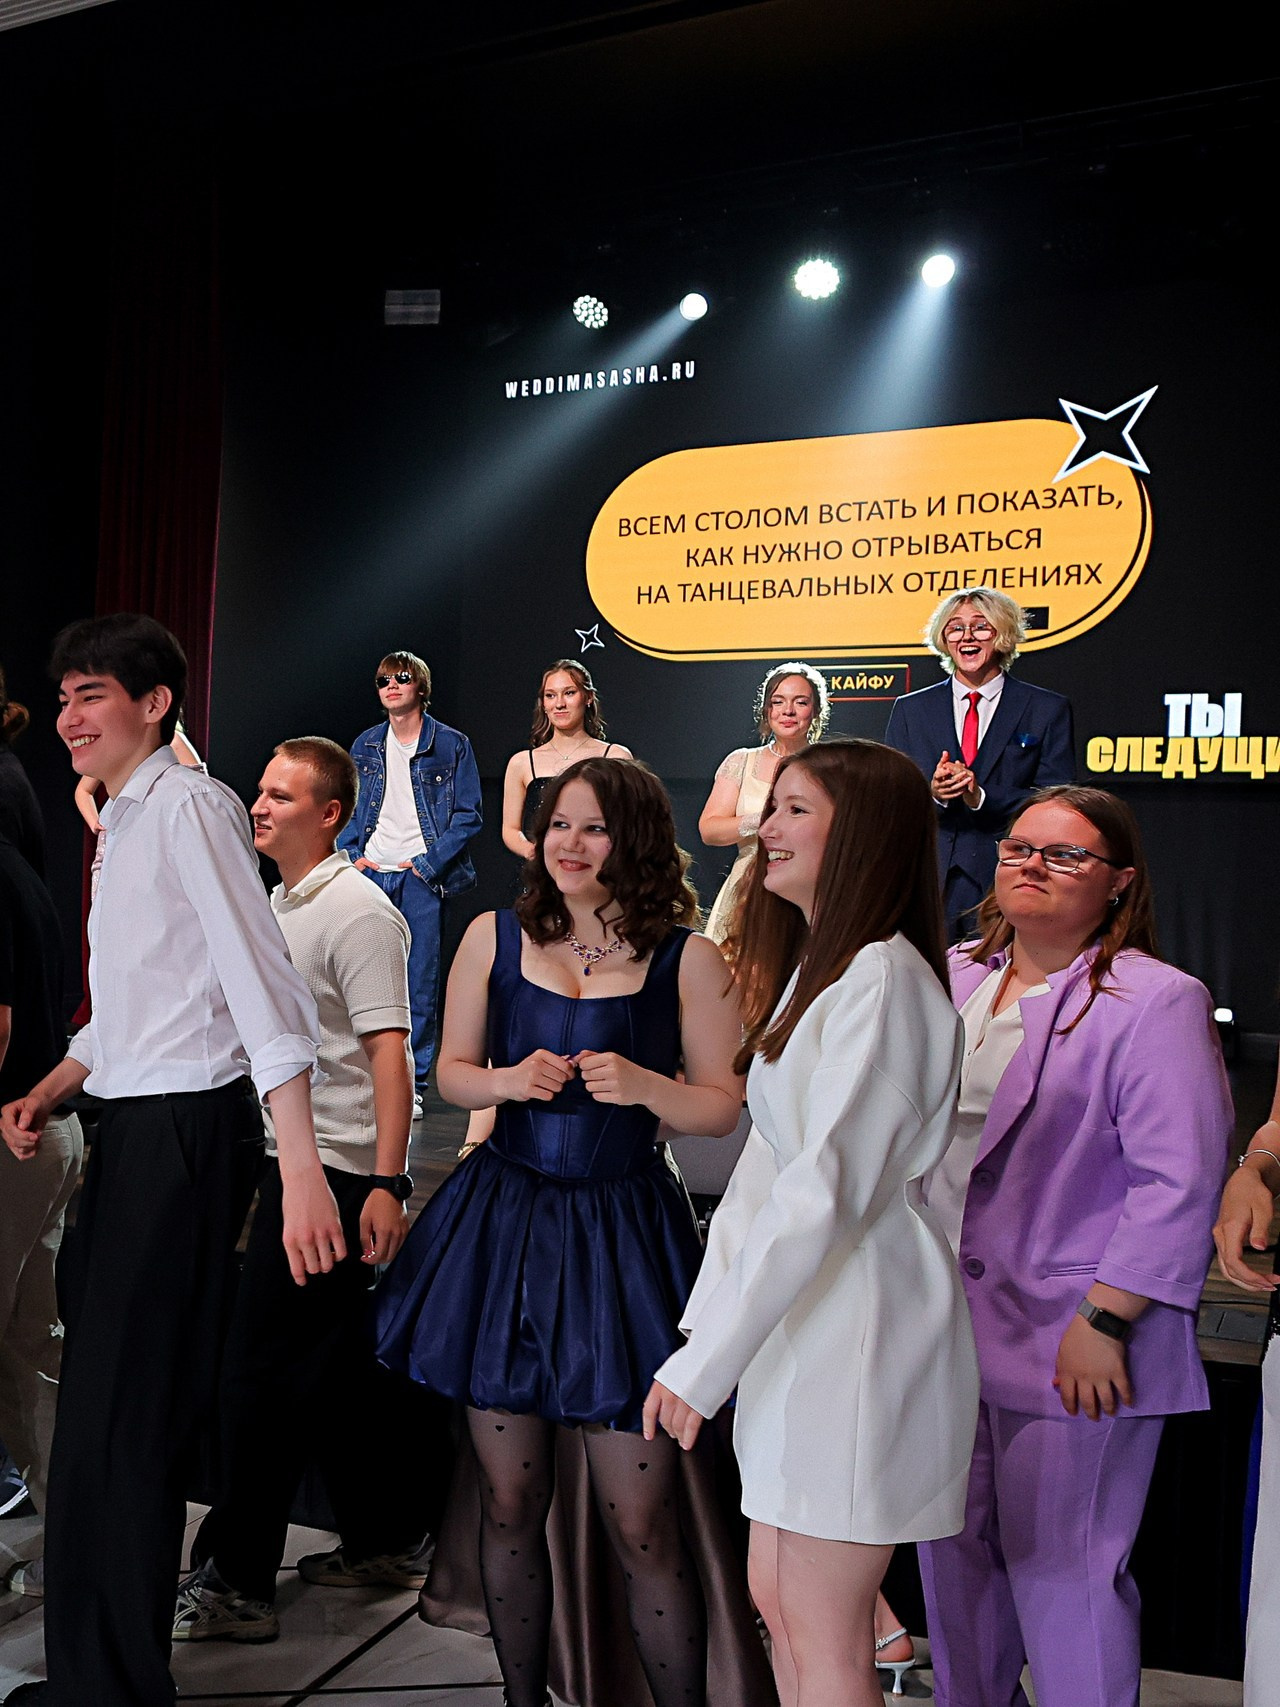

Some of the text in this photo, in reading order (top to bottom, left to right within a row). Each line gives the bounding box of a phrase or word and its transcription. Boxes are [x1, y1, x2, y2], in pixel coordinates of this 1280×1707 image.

[505, 360, 695, 398] WEDDIMASASHA.RU
[618, 484, 1123, 537] ВСЕМ СТОЛОМ ВСТАТЬ И ПОКАЗАТЬ,
[686, 528, 1042, 568] КАК НУЖНО ОТРЫВАТЬСЯ
[637, 562, 1103, 605] НА ТАНЦЕВАЛЬНЫХ ОТДЕЛЕНИЯХ
[831, 672, 895, 690] КАЙФУ
[1164, 692, 1243, 738] ТЫ
